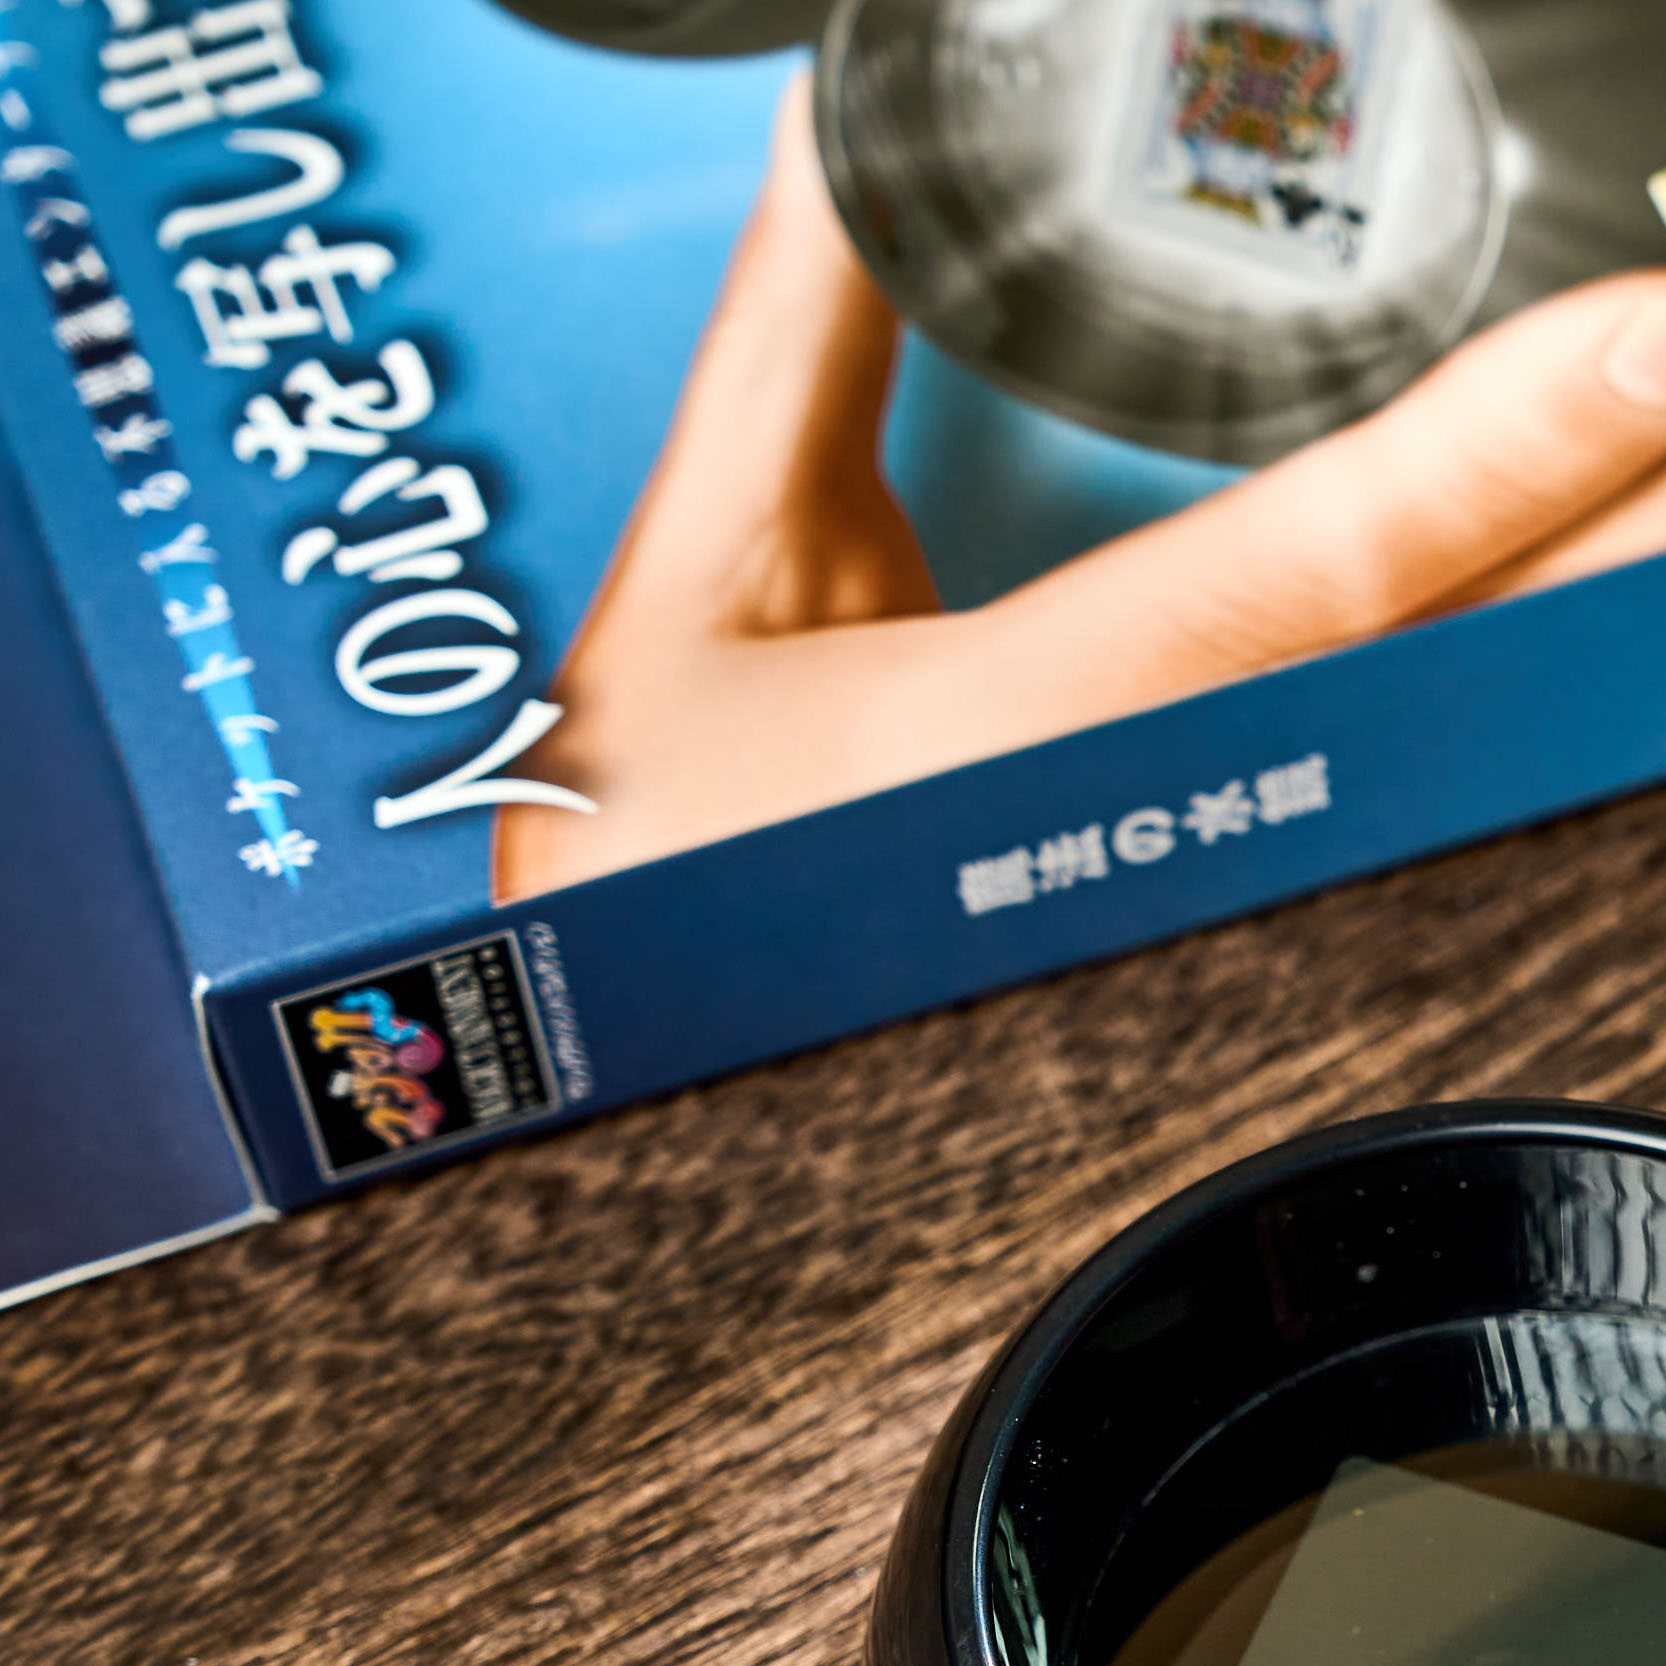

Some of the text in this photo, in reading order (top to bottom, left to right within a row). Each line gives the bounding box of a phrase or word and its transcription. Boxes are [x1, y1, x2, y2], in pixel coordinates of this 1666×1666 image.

[98, 0, 599, 829] 人の心を写し出
